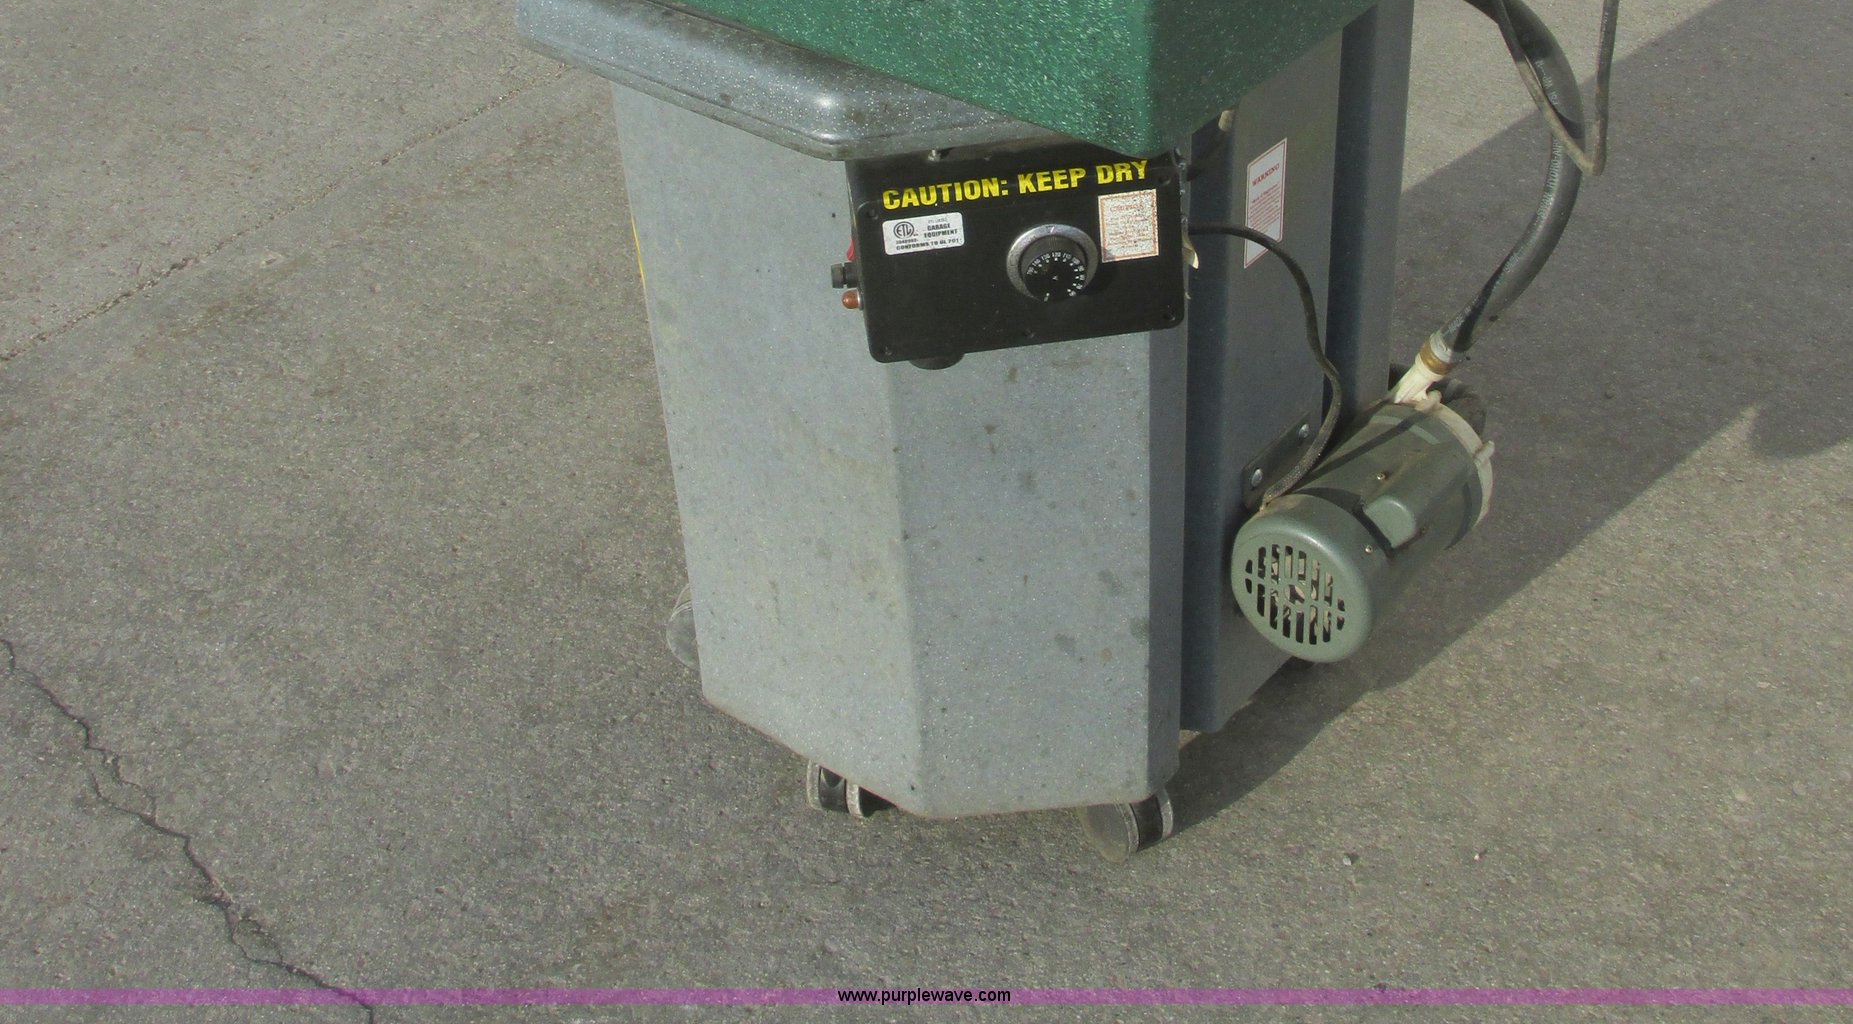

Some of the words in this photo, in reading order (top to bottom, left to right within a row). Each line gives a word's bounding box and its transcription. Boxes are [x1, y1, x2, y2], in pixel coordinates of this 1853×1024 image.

[882, 177, 1009, 210] CAUTION:
[1017, 167, 1087, 194] KEEP
[1095, 160, 1149, 185] DRY
[895, 223, 913, 238] ETL
[927, 223, 951, 231] GARAGE
[923, 228, 958, 239] EQUIPMENT
[896, 241, 930, 251] CONFORMS
